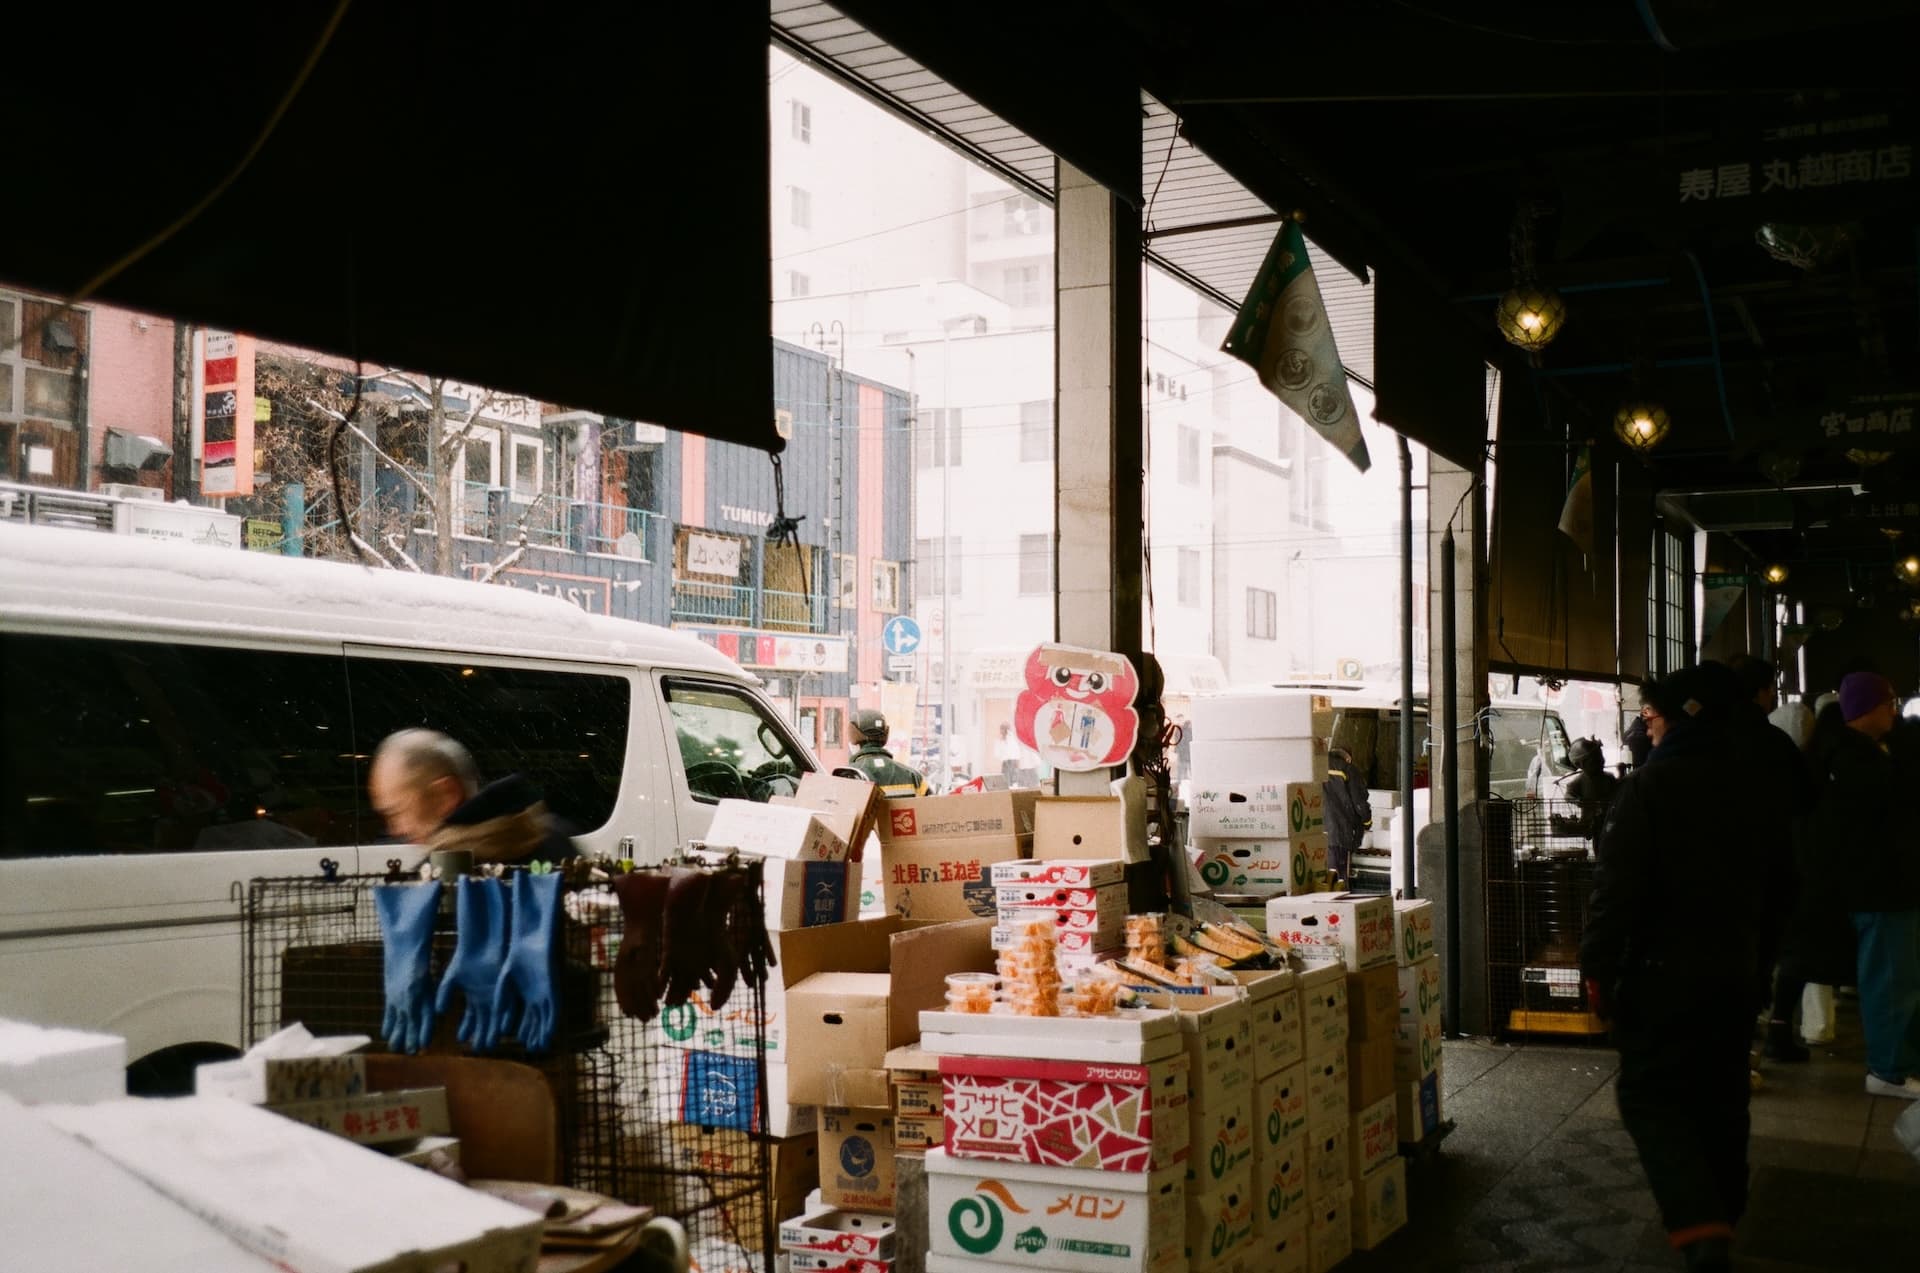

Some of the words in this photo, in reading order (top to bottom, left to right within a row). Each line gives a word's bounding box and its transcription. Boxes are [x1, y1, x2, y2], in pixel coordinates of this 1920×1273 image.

[1679, 164, 1751, 202] 寿屋
[1761, 145, 1913, 192] 丸越商店
[535, 581, 596, 613] EAST
[892, 859, 981, 885] 北見F1玉ねぎ
[1247, 860, 1281, 871] メロン
[1086, 1065, 1142, 1082] アサヒメロン
[959, 1092, 1019, 1118] アサヒ
[960, 1116, 1019, 1141] メロン
[1046, 1193, 1126, 1221] メロン
